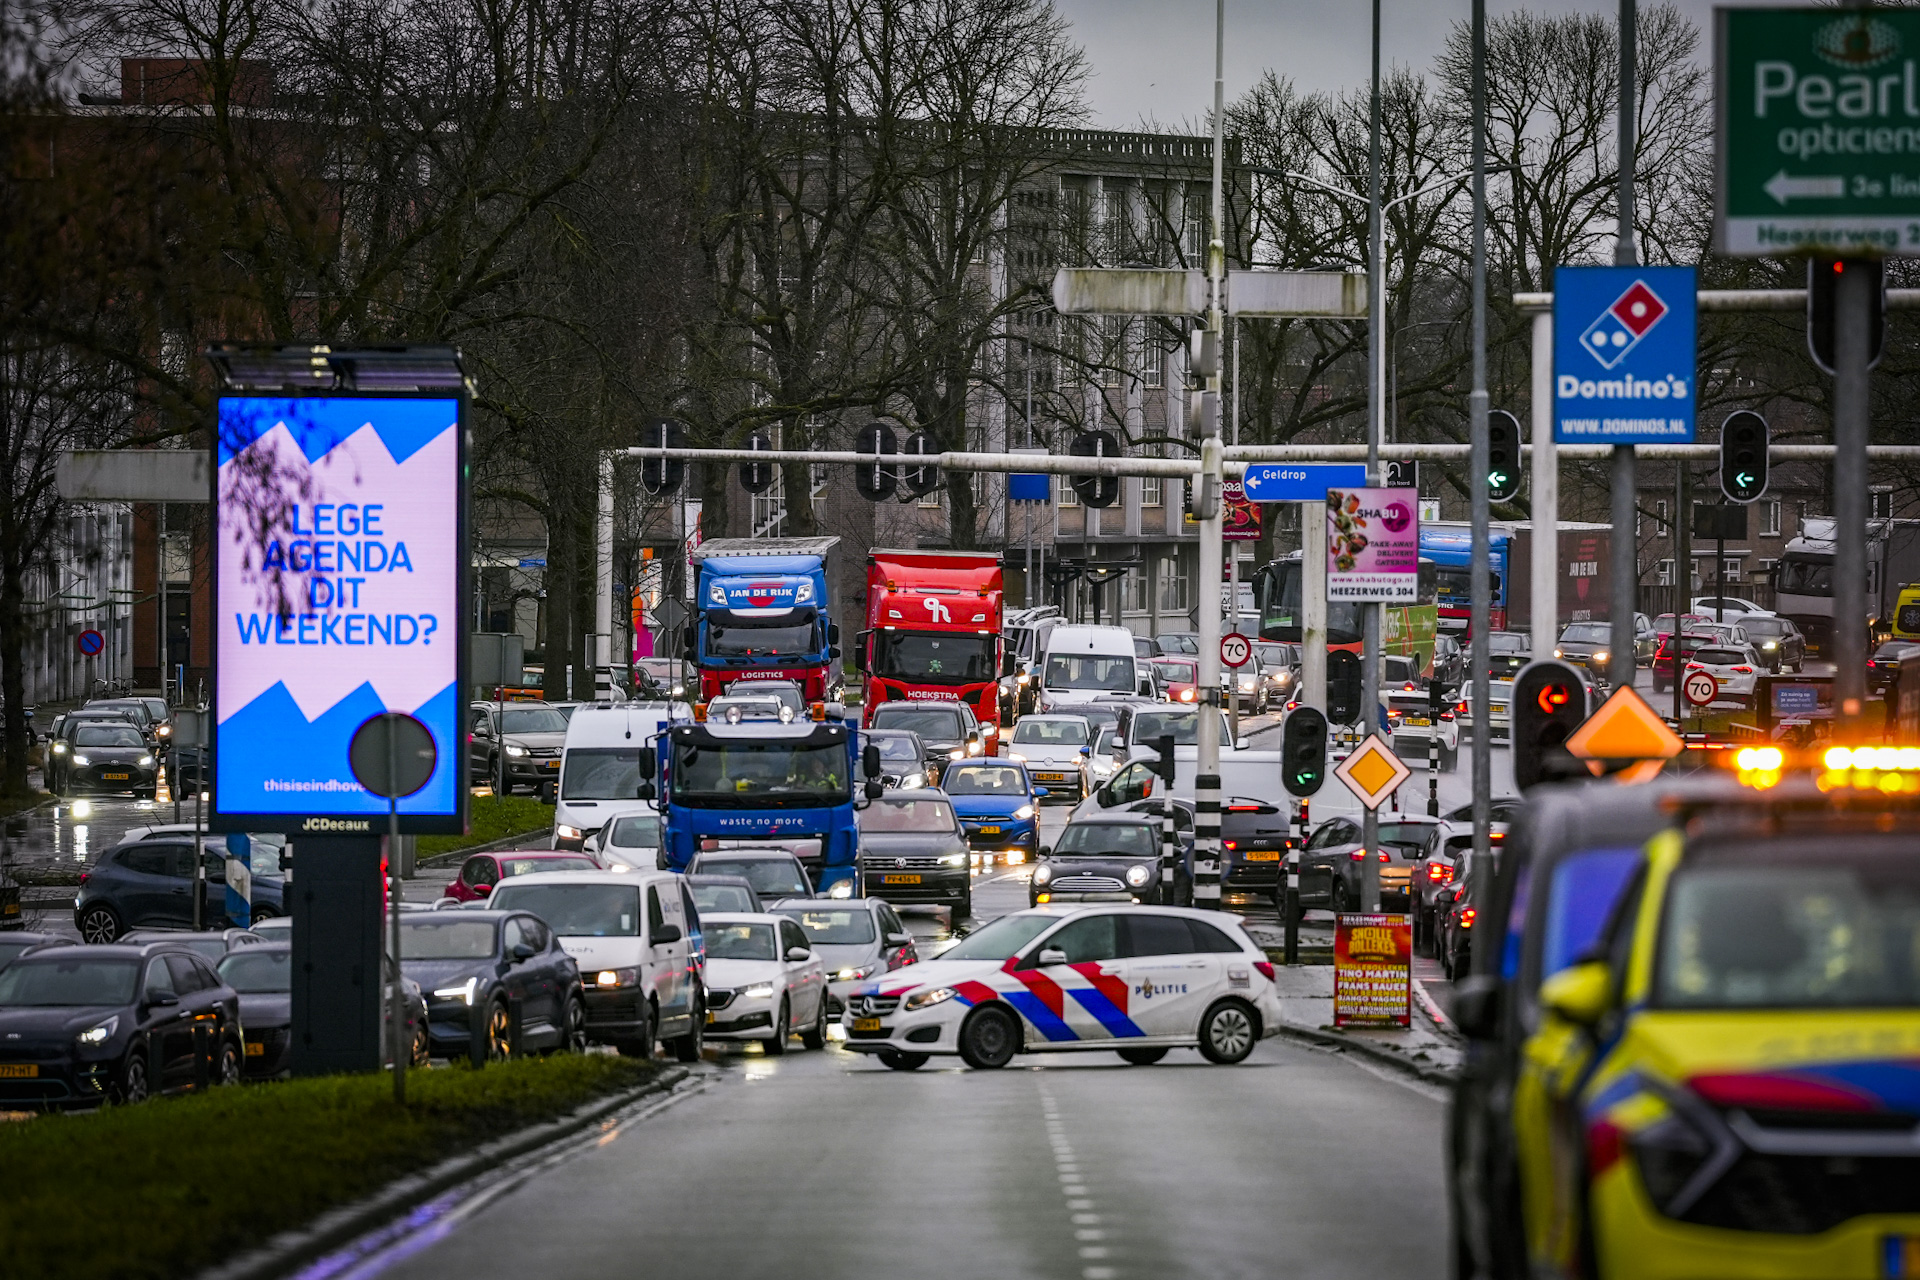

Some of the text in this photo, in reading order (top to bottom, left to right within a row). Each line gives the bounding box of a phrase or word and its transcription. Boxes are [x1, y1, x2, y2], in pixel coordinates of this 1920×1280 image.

[1853, 173, 1920, 197] 3e lin
[1757, 224, 1898, 247] Heezerweg
[1558, 373, 1688, 399] Domino's
[1561, 418, 1687, 435] WWW.DOMINOS.NL
[1262, 469, 1307, 480] Geldrop
[293, 504, 383, 536] LEGE
[1357, 508, 1399, 519] SHABU
[262, 540, 413, 572] AGENDA
[1569, 562, 1579, 576] JAN
[1580, 562, 1586, 576] DE
[1332, 576, 1413, 584] www.shabutogo.nl
[309, 577, 366, 608] DIT
[730, 588, 793, 597] JAN DE RIJK
[1331, 587, 1413, 595] HEEZERWEG 304
[236, 613, 437, 645] WEEKEND?
[1224, 643, 1246, 657] 70
[741, 671, 784, 679] LOGISTICS
[907, 690, 959, 700] HOEKSTRA
[1690, 682, 1711, 696] 70
[302, 818, 369, 831] JCDecaux
[720, 817, 752, 825] waste
[1338, 969, 1408, 978] TINO MARTIN
[1135, 983, 1187, 999] POLITIE
[1338, 981, 1407, 991] FRANS BAUER
